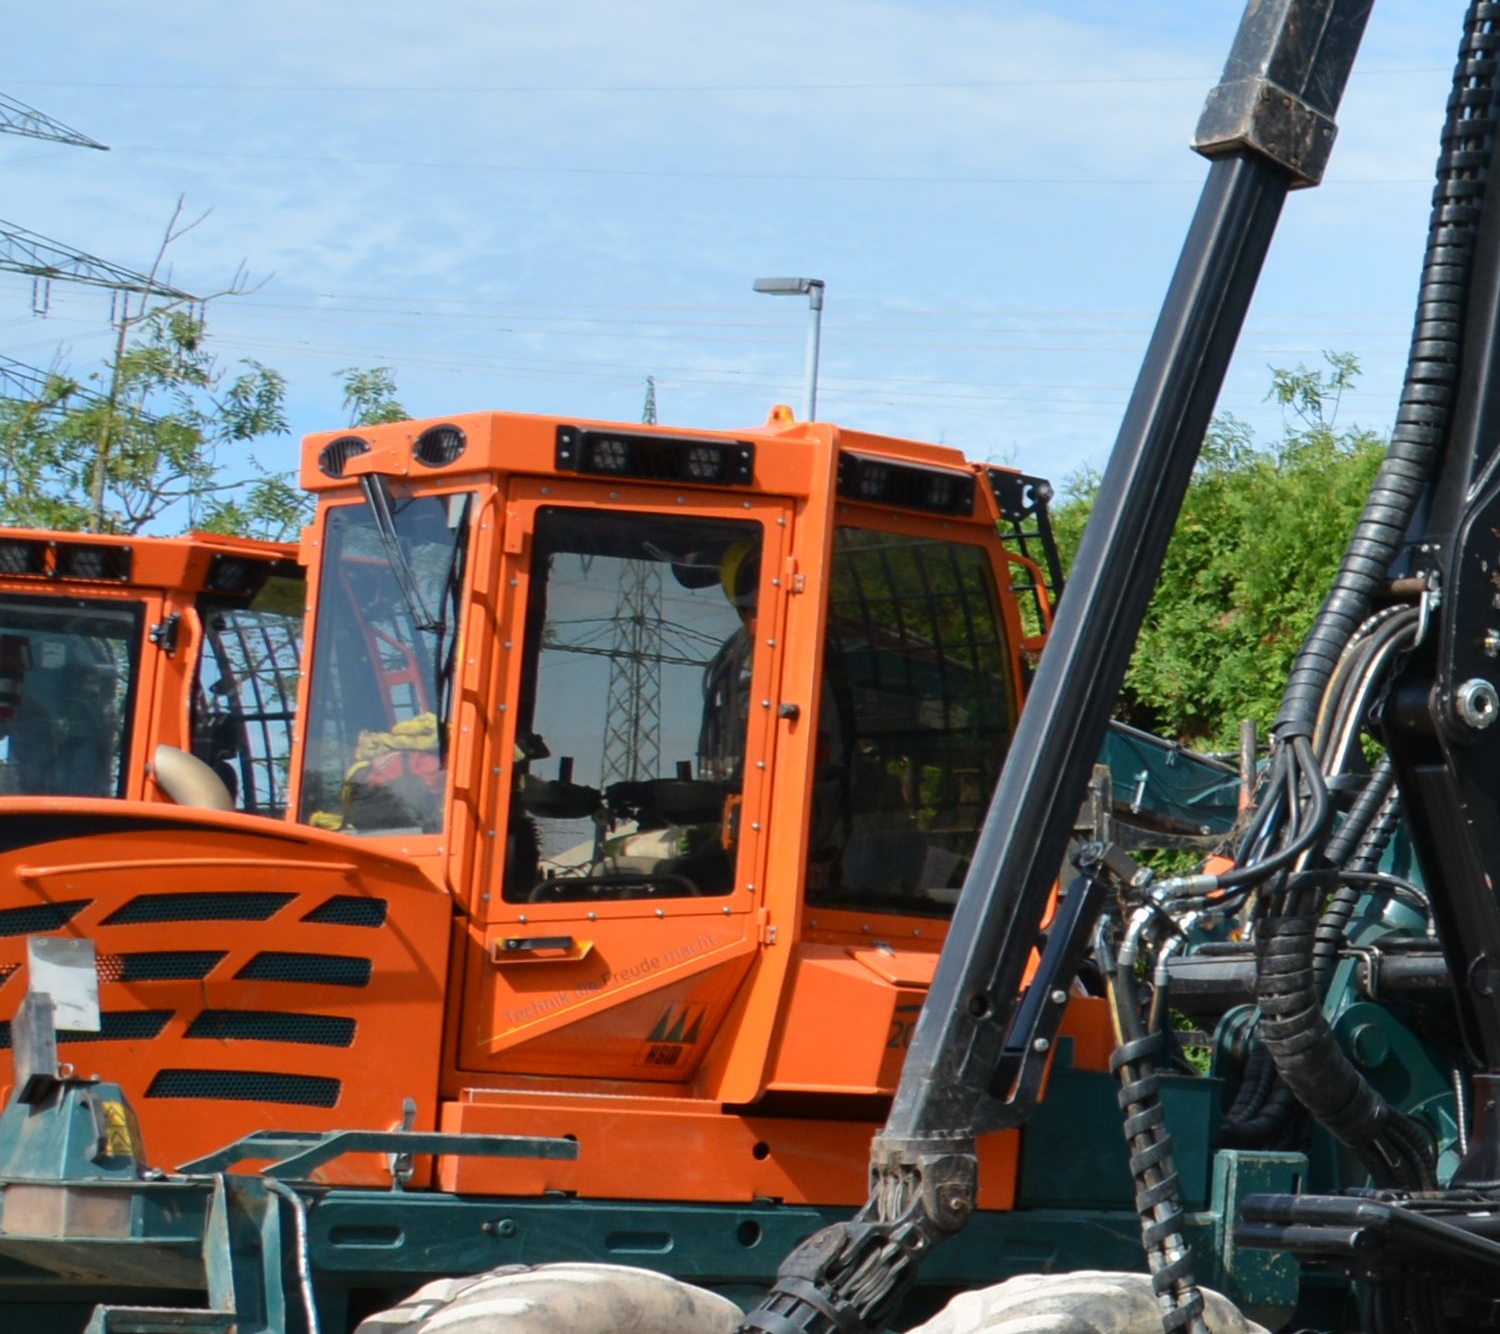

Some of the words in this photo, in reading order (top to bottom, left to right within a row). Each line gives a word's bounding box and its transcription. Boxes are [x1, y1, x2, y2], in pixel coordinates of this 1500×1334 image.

[504, 993, 570, 1025] Technik
[575, 979, 599, 999] die
[602, 955, 661, 988] Freude
[664, 934, 718, 964] macht
